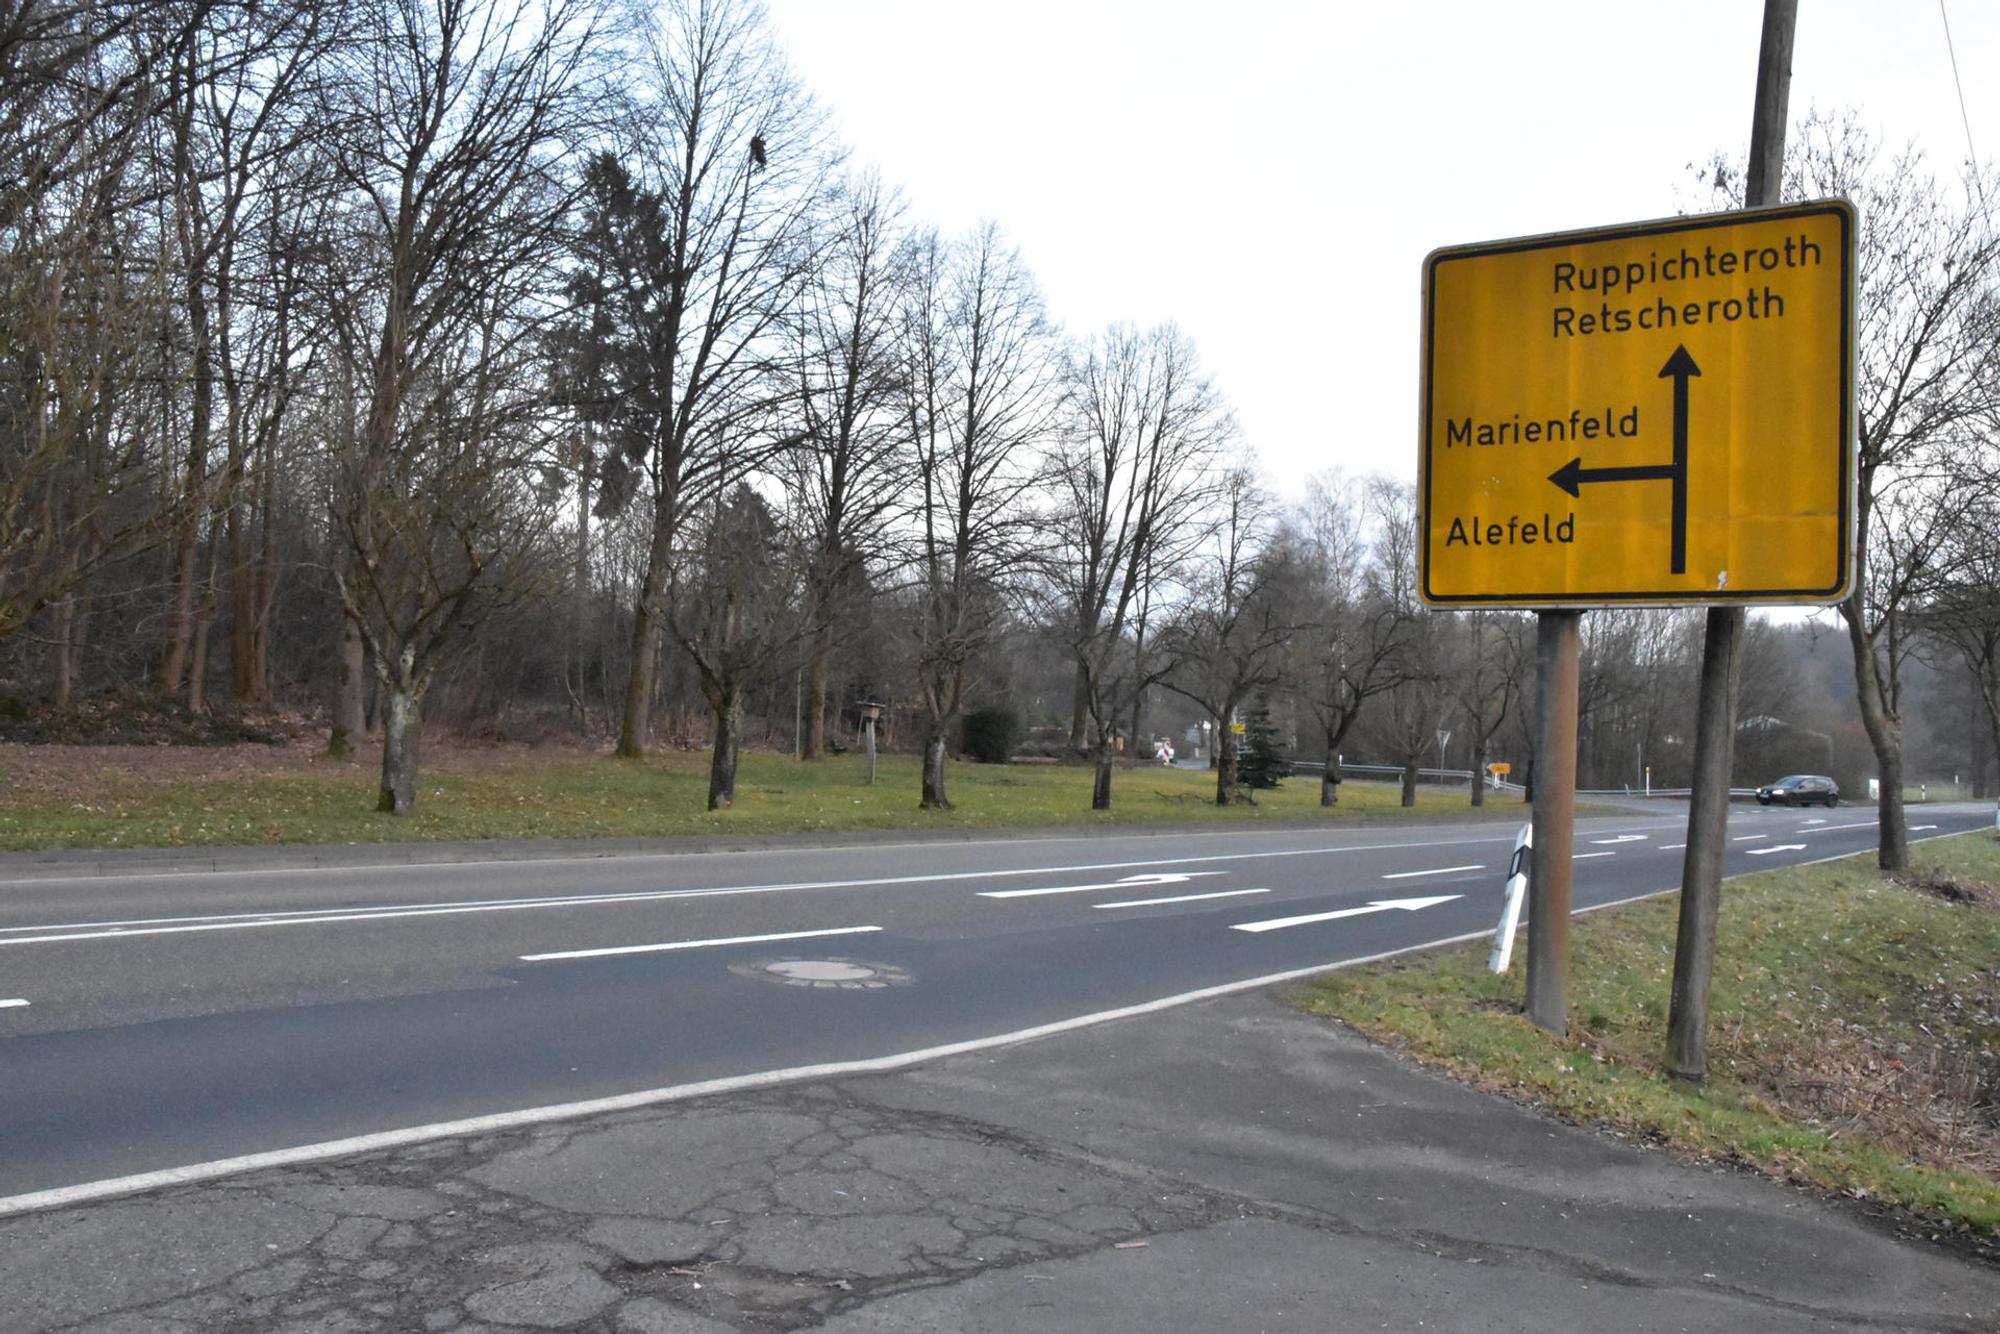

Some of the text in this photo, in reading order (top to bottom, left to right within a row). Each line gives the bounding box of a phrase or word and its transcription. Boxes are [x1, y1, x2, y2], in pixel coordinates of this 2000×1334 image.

[1554, 235, 1821, 294] Ruppichteroth
[1553, 287, 1784, 338] Retscheroth
[1446, 406, 1638, 448] Marienfeld
[1446, 513, 1575, 546] Alefeld
